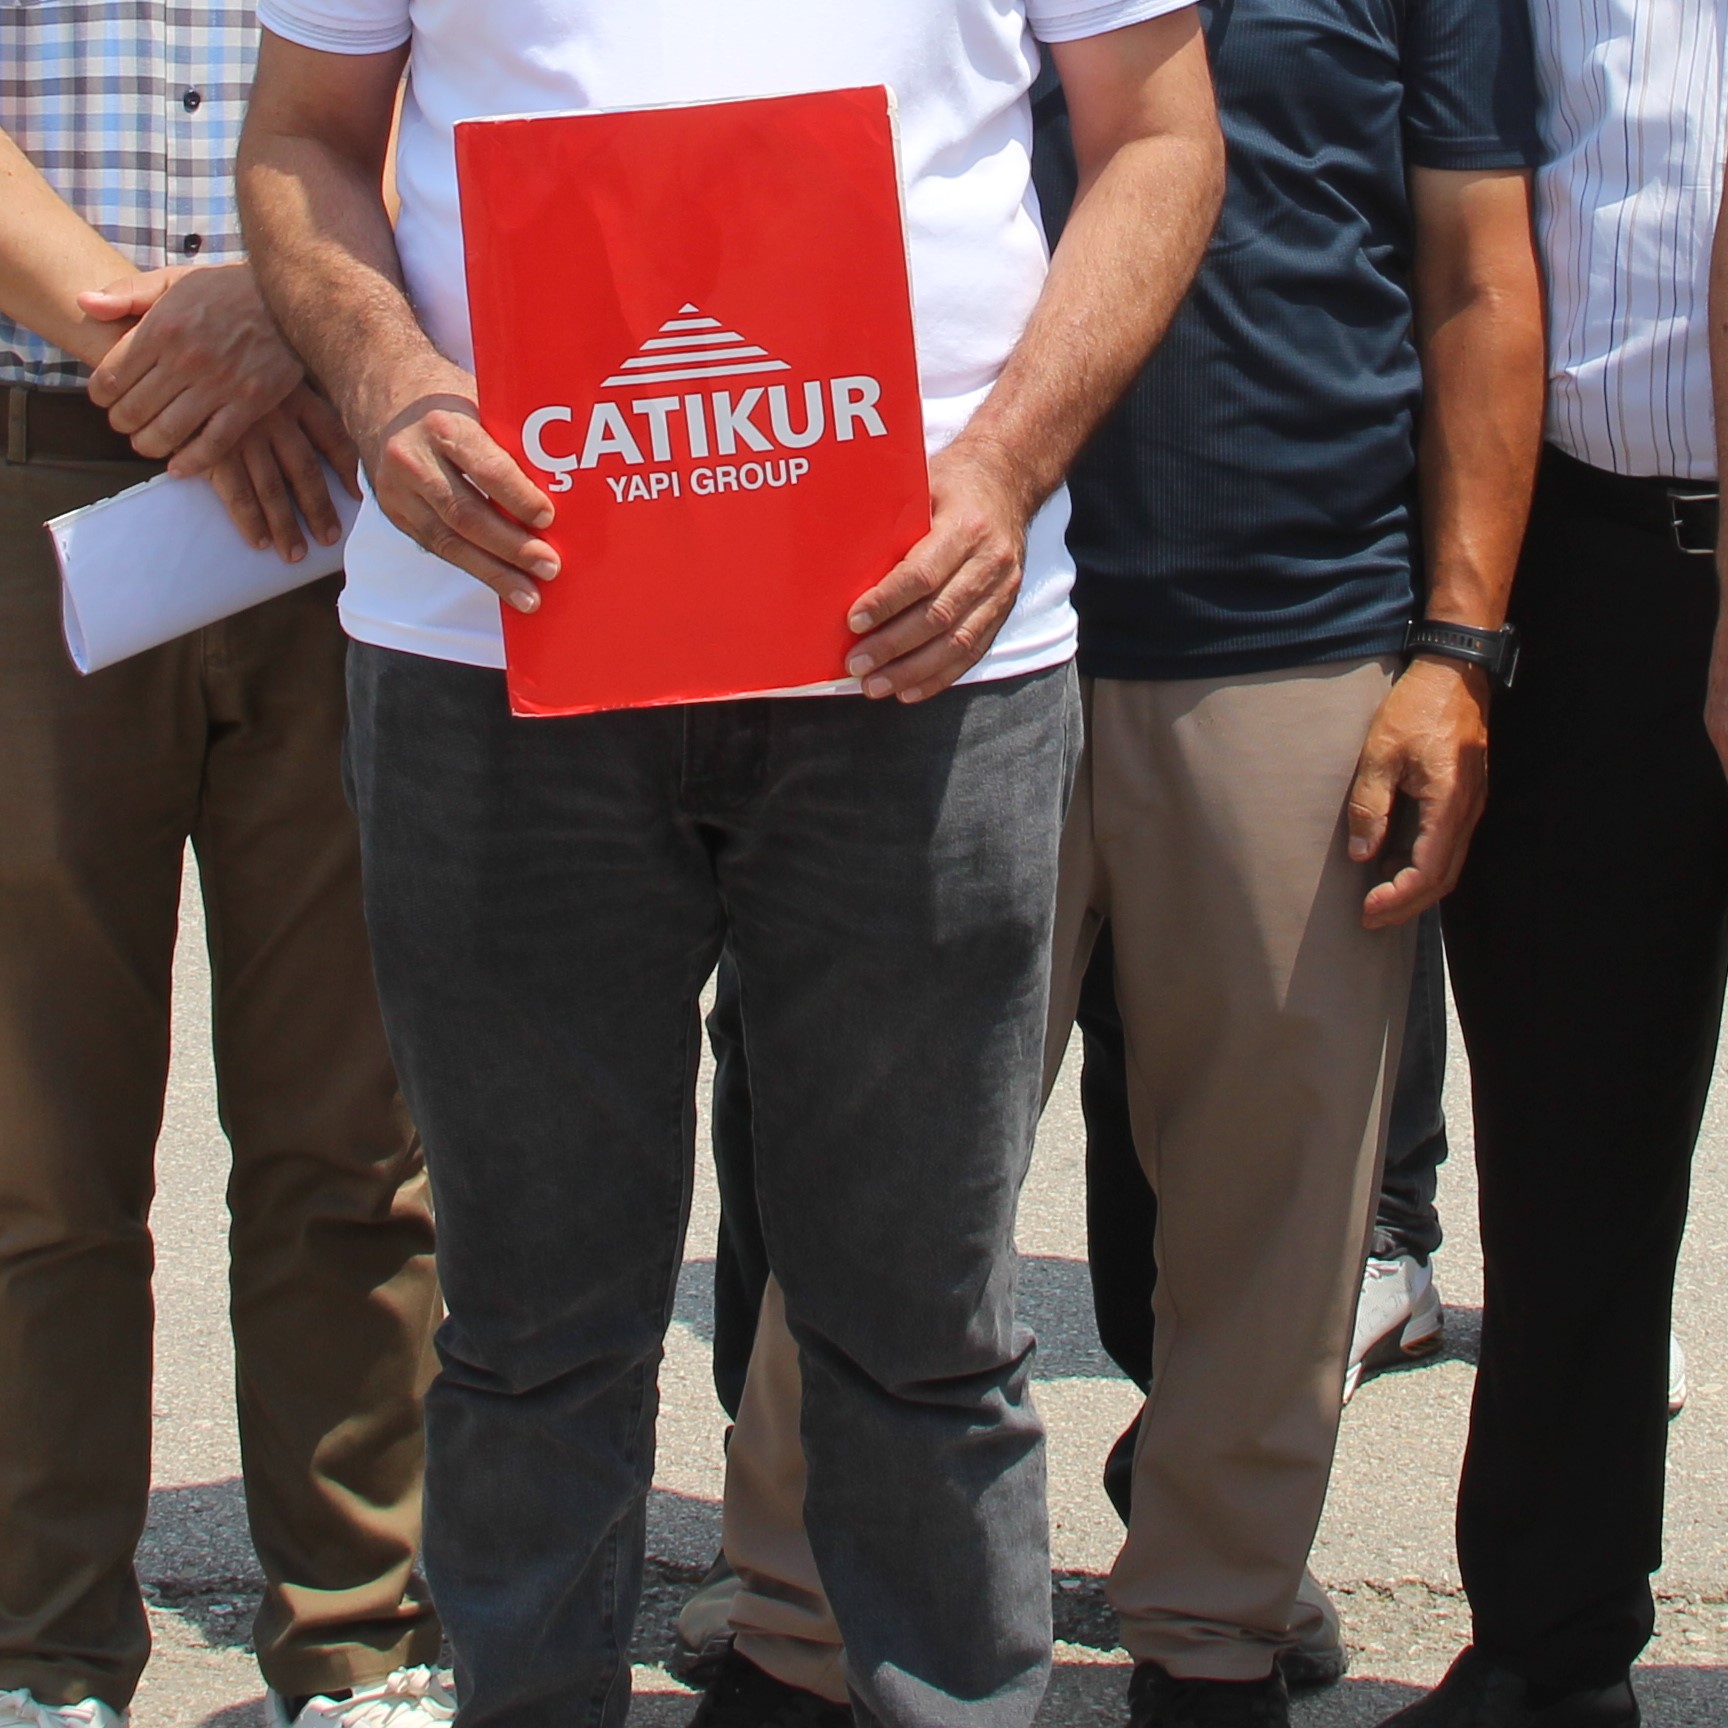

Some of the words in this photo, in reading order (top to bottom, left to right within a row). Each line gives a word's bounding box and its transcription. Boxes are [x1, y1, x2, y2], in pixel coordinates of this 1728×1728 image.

[521, 375, 888, 492] ÇATIKUR
[606, 470, 681, 504] YAPI
[690, 457, 810, 496] GROUP
